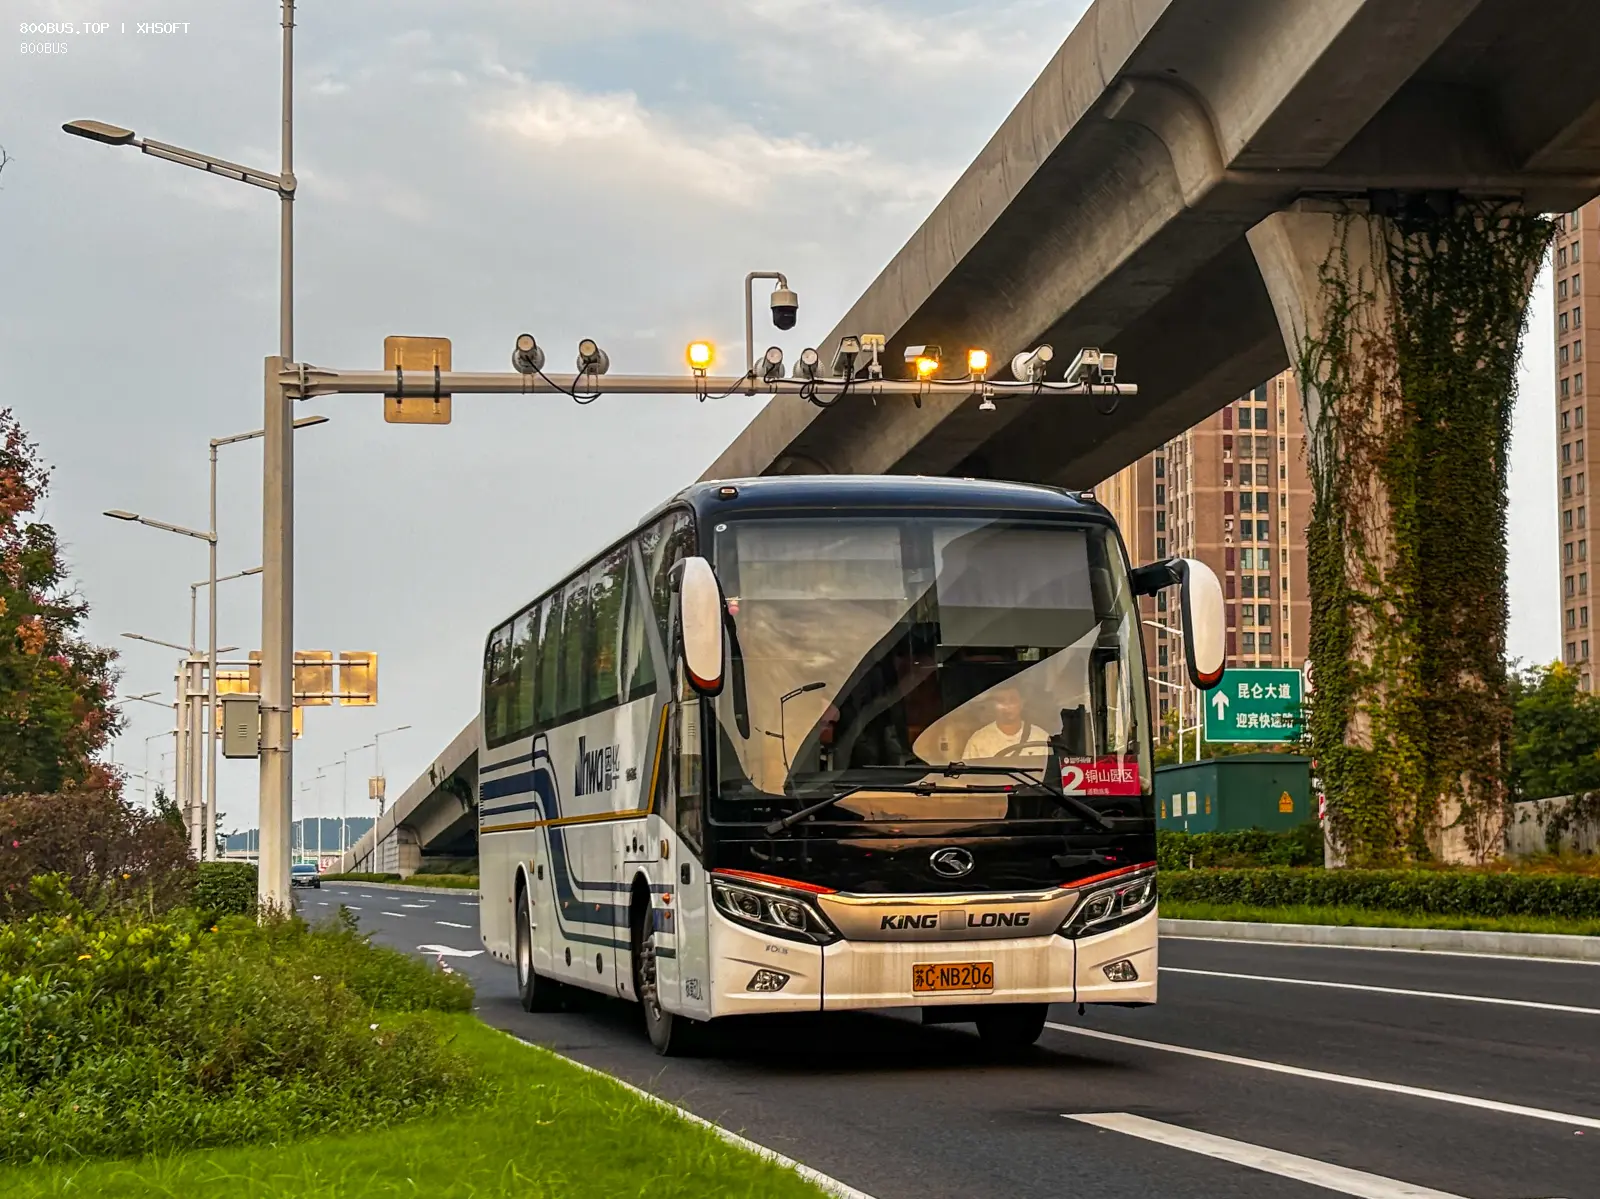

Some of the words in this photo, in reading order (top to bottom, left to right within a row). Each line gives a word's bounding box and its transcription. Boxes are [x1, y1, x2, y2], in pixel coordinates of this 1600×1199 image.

[1237, 682, 1291, 699] 昆仑大道
[1061, 765, 1087, 796] 2
[1085, 768, 1134, 784] 铜山园区
[967, 912, 1031, 928] LONG
